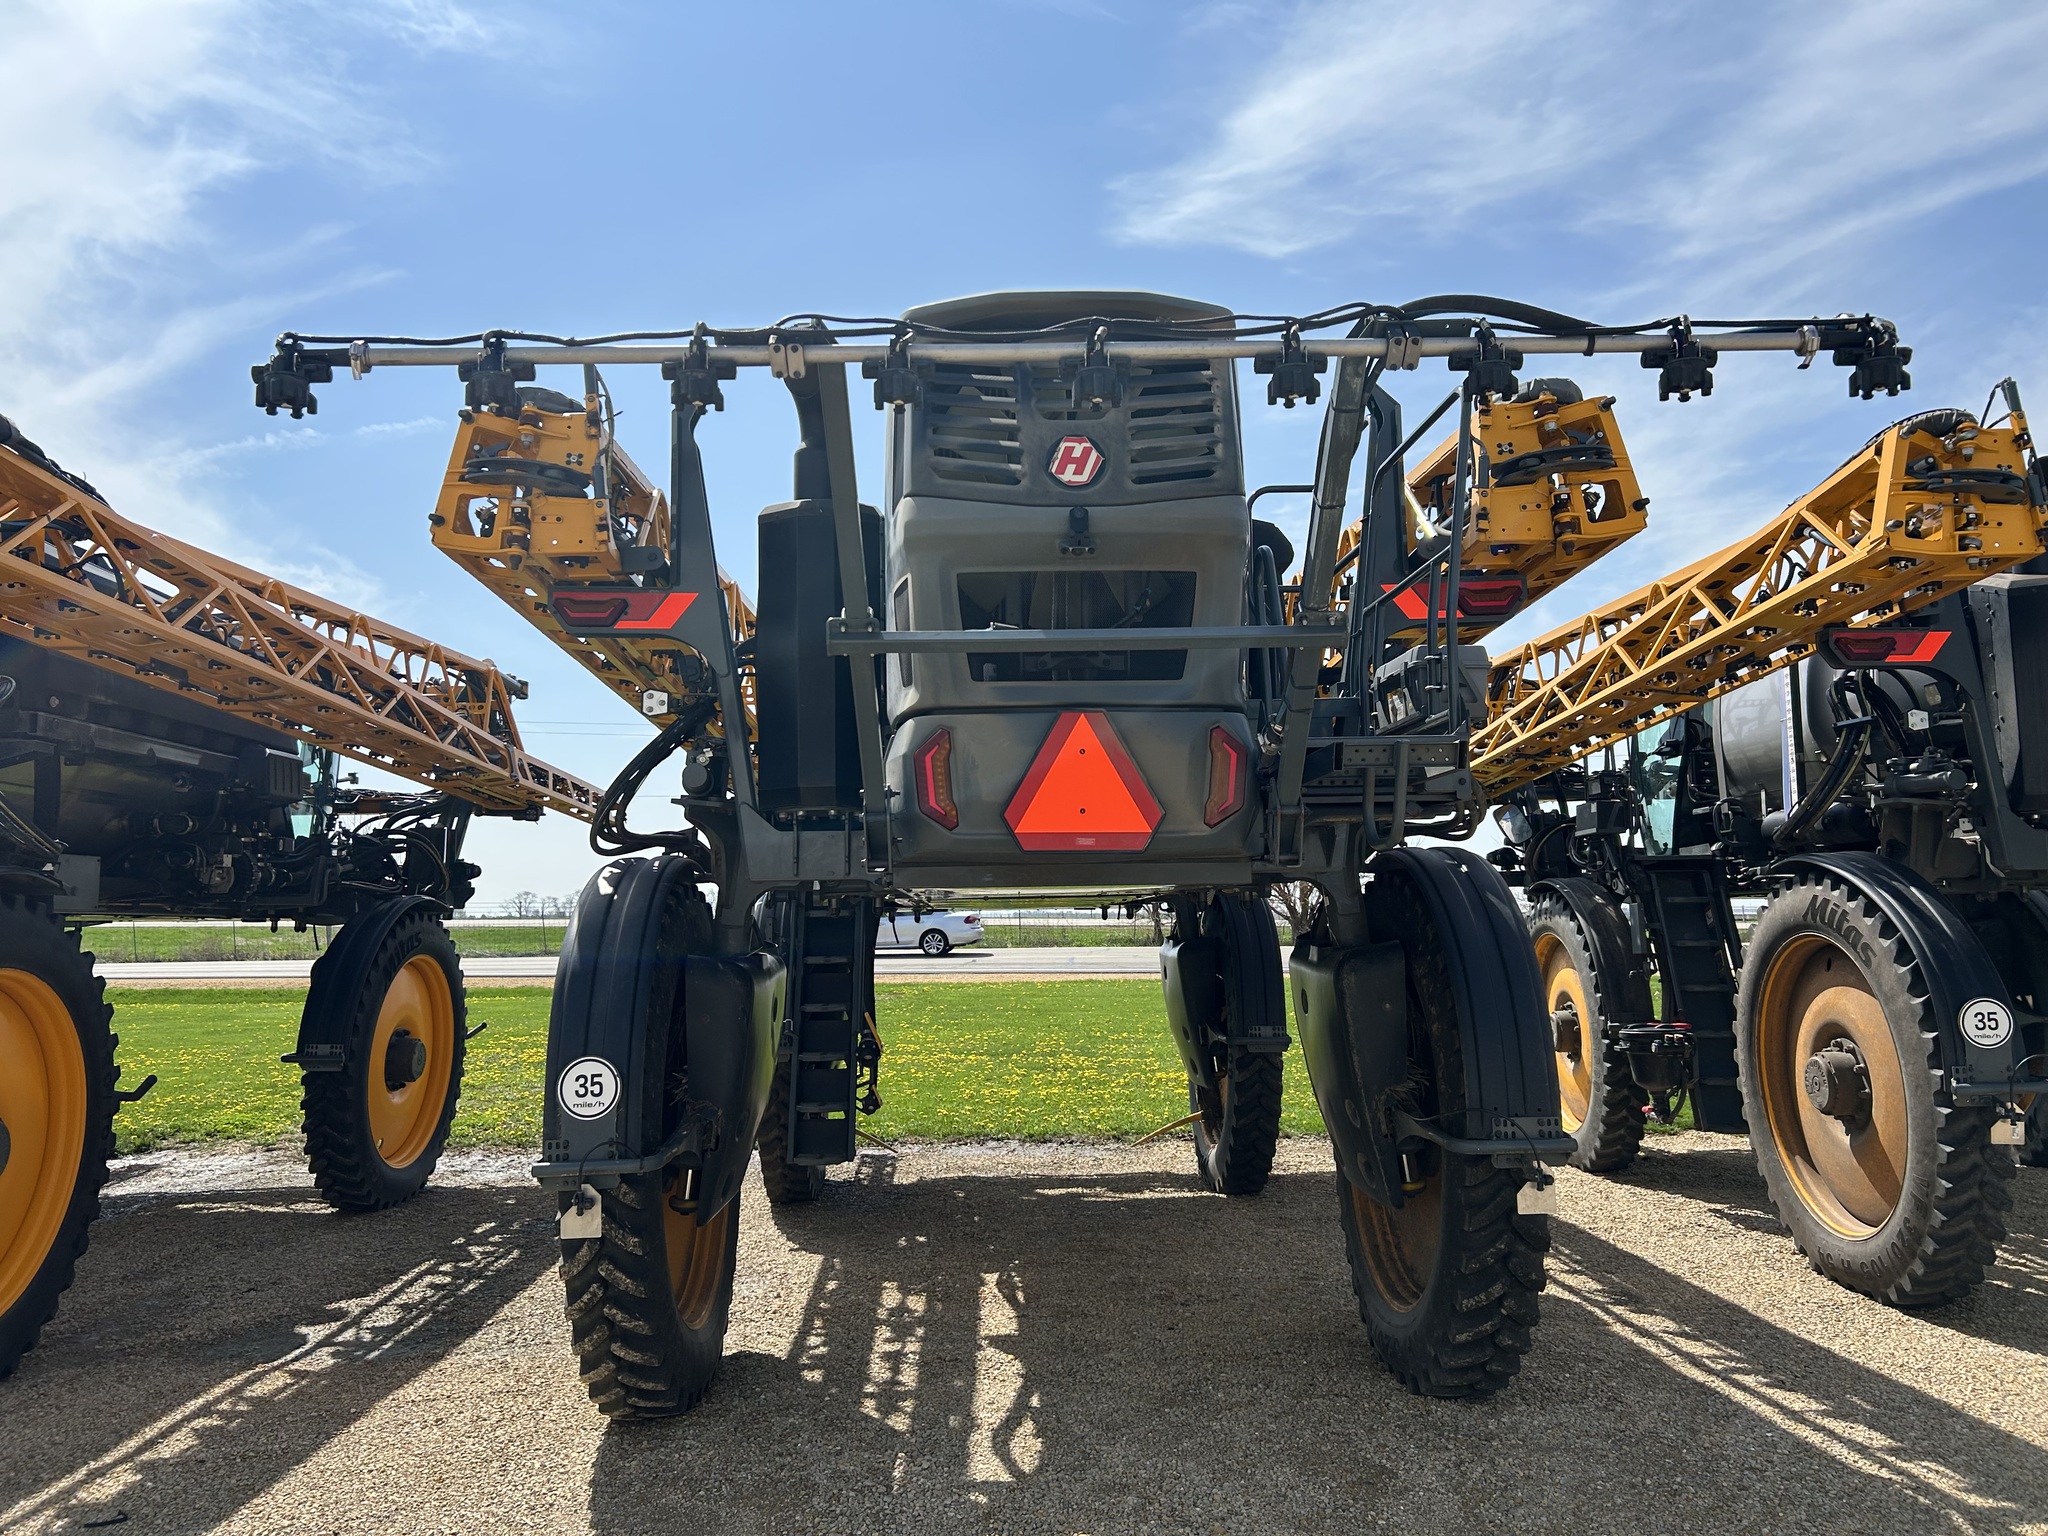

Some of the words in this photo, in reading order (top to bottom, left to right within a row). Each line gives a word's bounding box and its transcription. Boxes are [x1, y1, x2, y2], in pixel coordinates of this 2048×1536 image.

[1051, 442, 1098, 482] H
[1802, 894, 1877, 969] Mitas
[1974, 1012, 1999, 1031] 35
[574, 1073, 604, 1098] 35
[573, 1101, 605, 1109] mile/h
